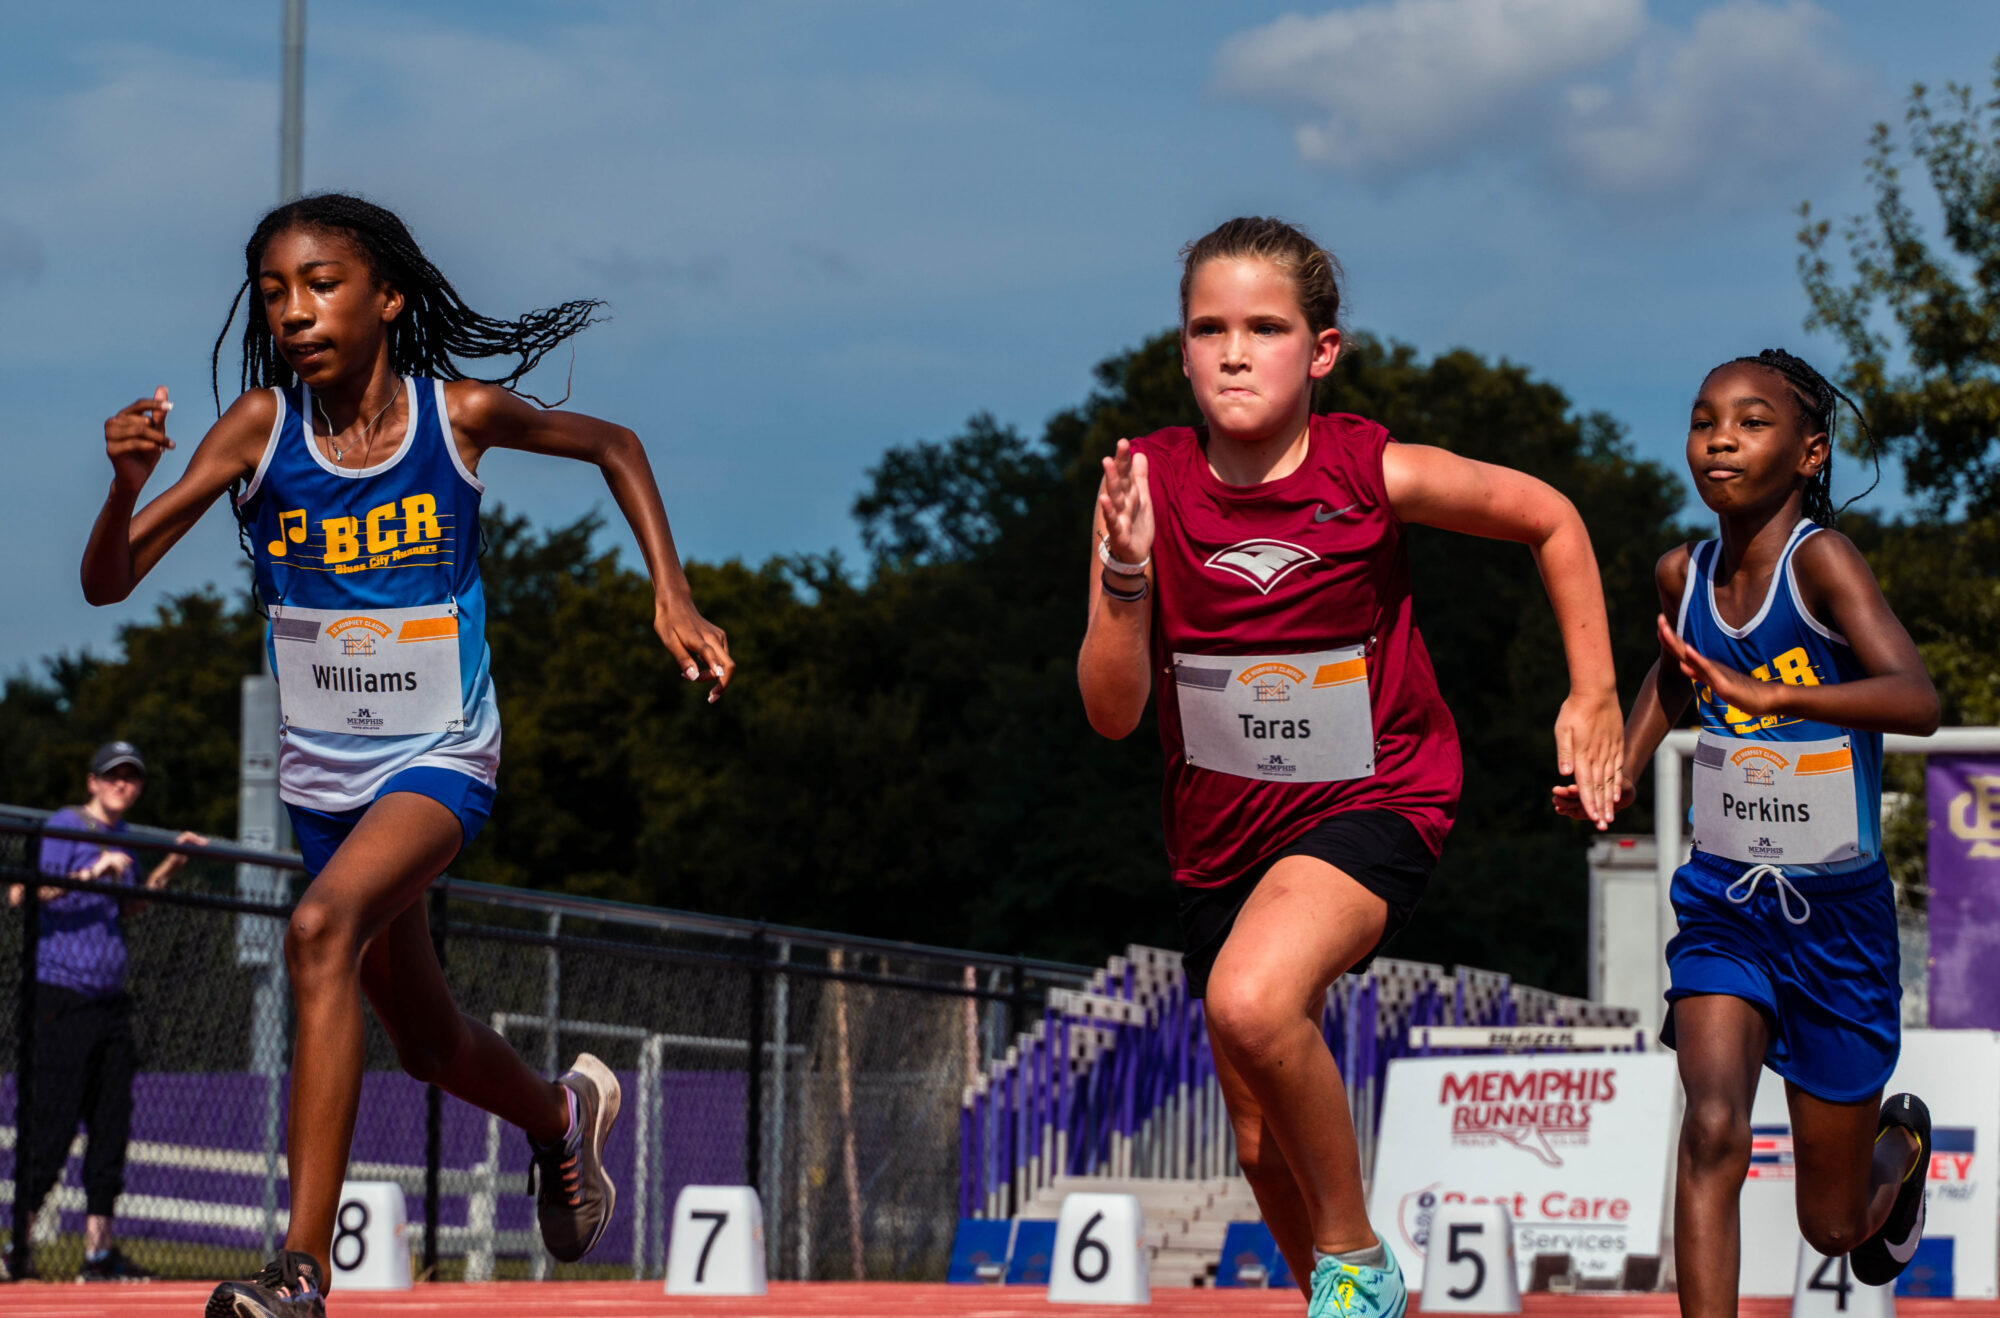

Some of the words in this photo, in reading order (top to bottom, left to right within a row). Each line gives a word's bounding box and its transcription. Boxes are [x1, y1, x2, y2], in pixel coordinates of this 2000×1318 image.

[322, 493, 441, 565] BCR
[335, 563, 367, 575] Blues
[369, 554, 390, 569] City
[392, 544, 438, 561] Runners
[312, 664, 417, 693] Williams
[346, 717, 384, 725] MEMPHIS
[1238, 714, 1311, 739] Taras
[1257, 764, 1296, 772] MEMPHIS
[1723, 793, 1811, 823] Perkins
[1748, 846, 1784, 854] MEMPHIS
[1440, 1069, 1617, 1105] MEMPHIS
[1453, 1103, 1592, 1129] RUNNERS
[1540, 1191, 1631, 1221] Care
[332, 1200, 369, 1271] 8
[691, 1211, 729, 1283] 7
[1073, 1211, 1110, 1283] 6
[1519, 1230, 1627, 1251] Services
[1447, 1223, 1485, 1302] 5
[1806, 1256, 1854, 1311] 4
